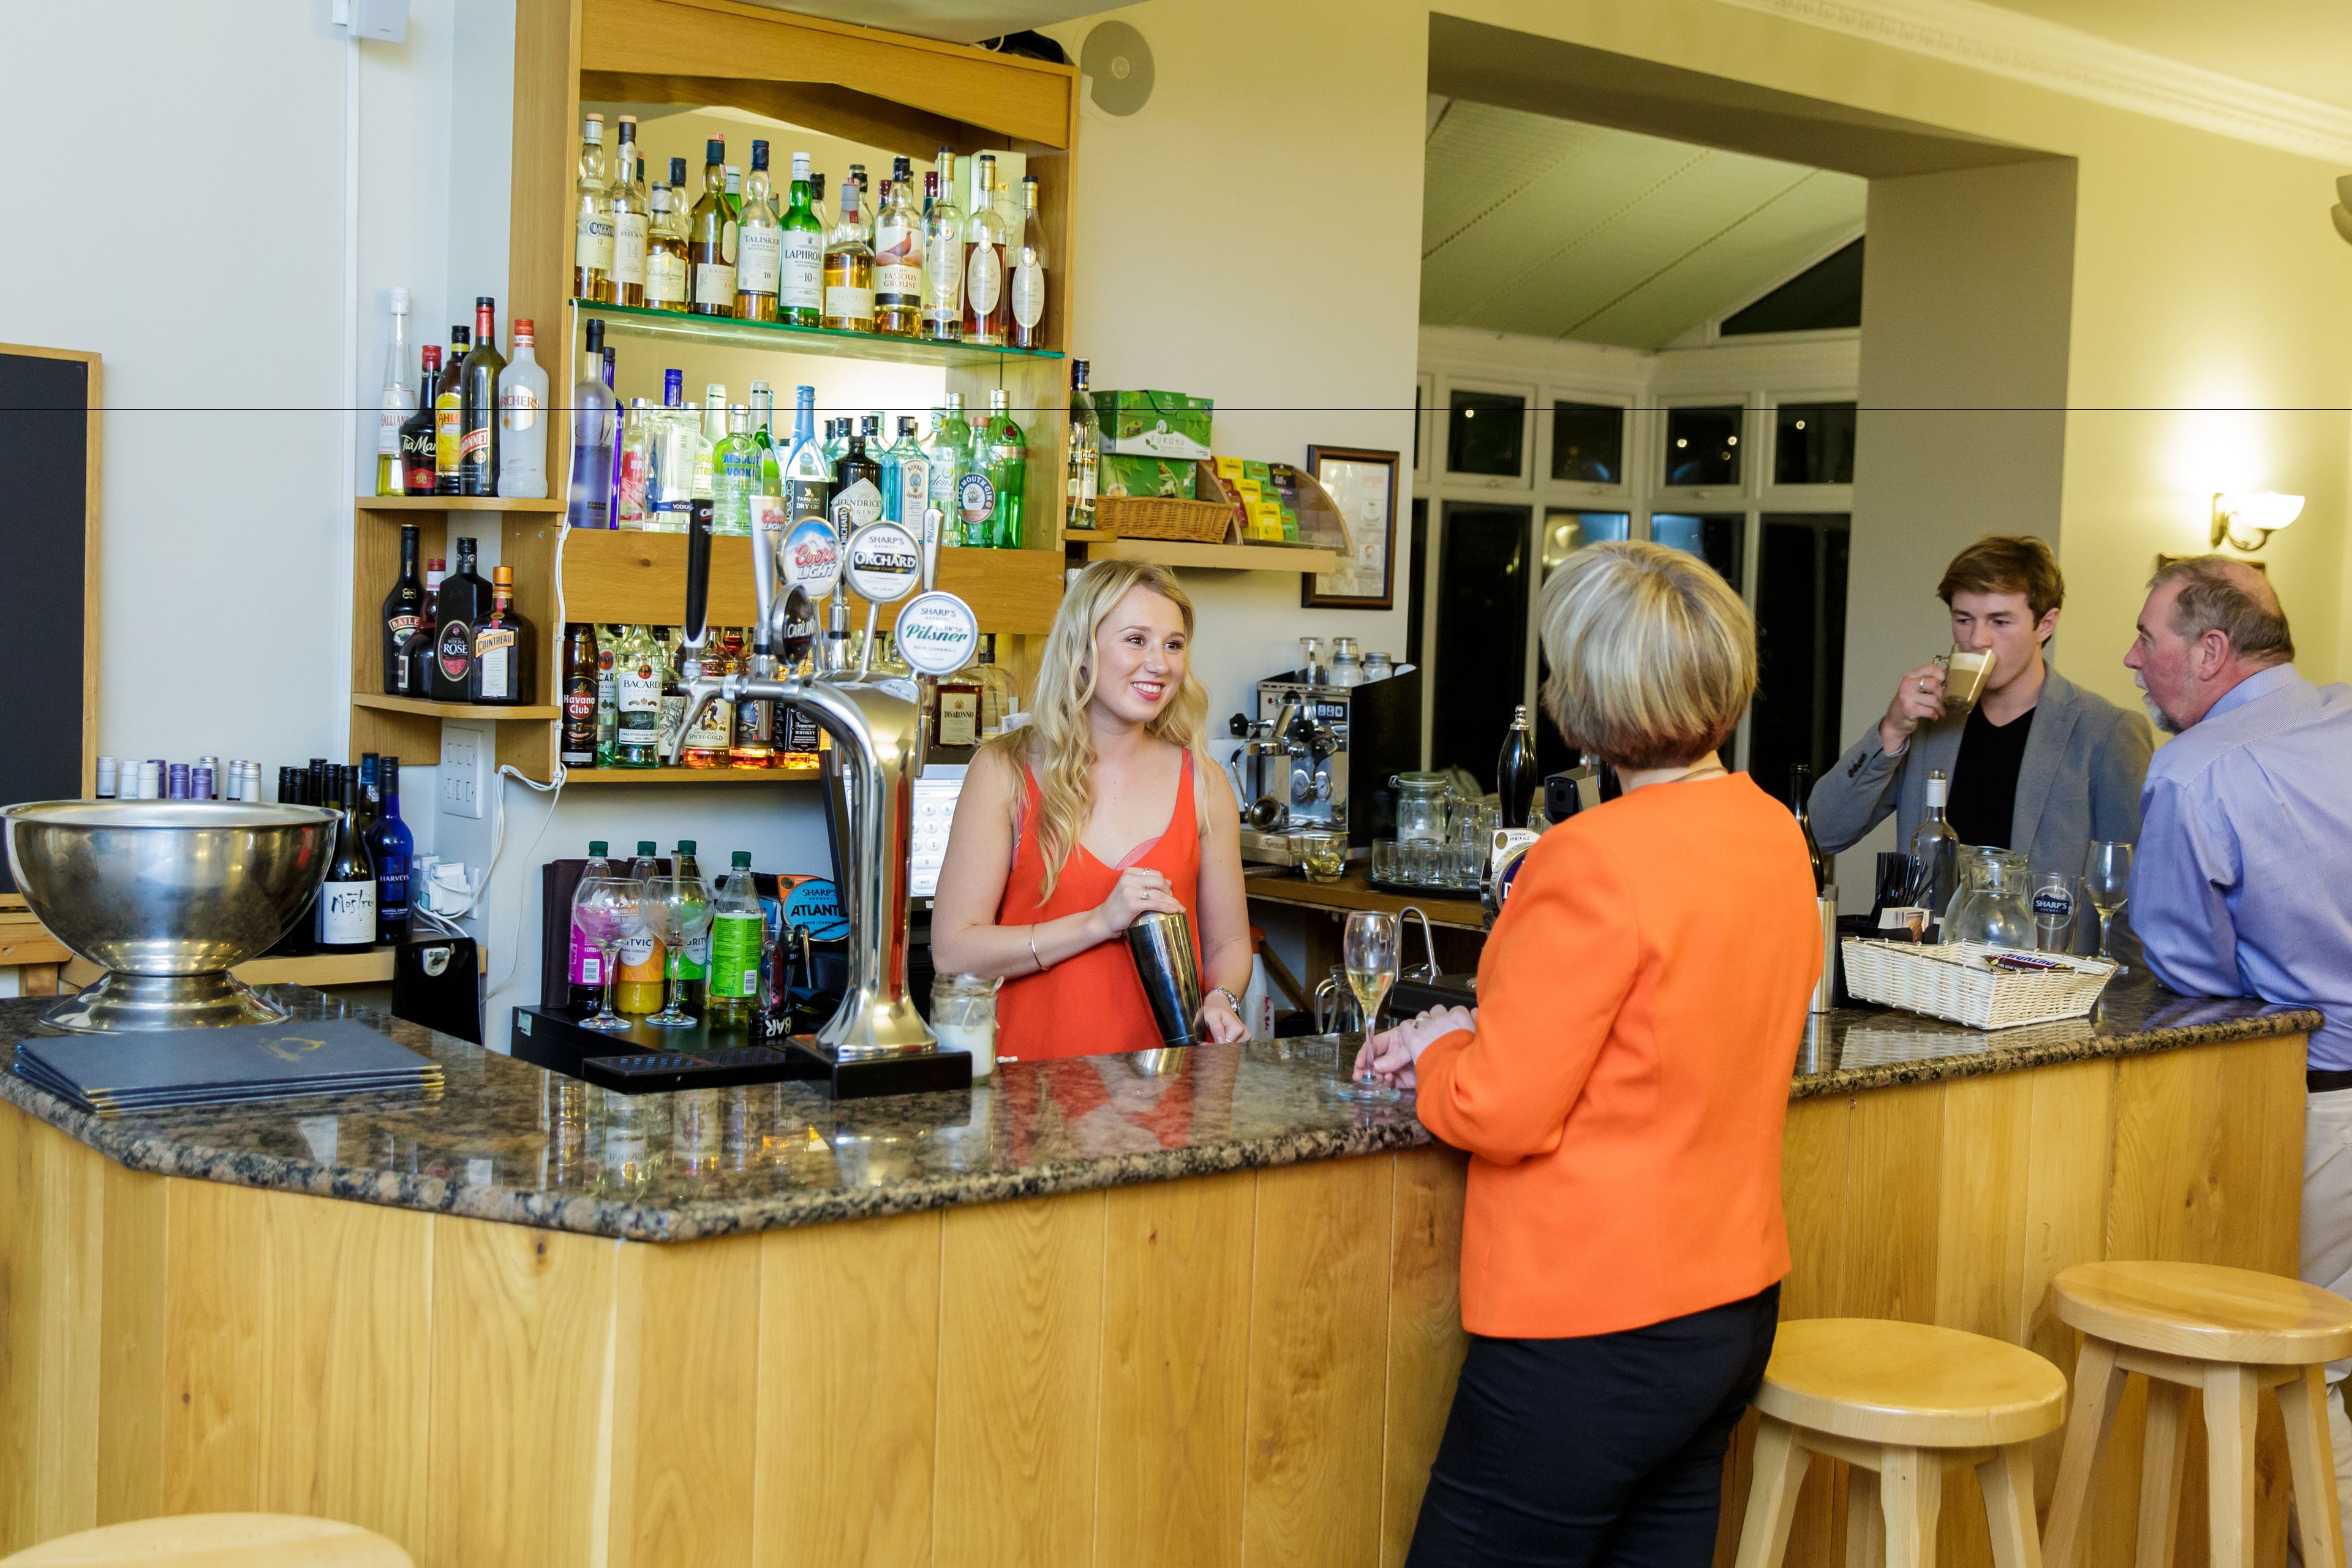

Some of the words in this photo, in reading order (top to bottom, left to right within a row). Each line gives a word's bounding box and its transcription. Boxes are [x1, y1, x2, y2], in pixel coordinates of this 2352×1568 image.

[621, 231, 644, 239] OBAN
[804, 273, 813, 282] 10
[884, 273, 918, 282] FAMOUS
[883, 280, 916, 289] GROUSE
[500, 396, 540, 409] RCHERS
[401, 435, 415, 452] Tia
[723, 454, 760, 466] ABSOLUT
[726, 467, 756, 477] VODKA
[930, 475, 954, 486] don's
[984, 484, 993, 501] GIN
[927, 514, 937, 544] Pilsner
[869, 535, 905, 545] SHARP'S
[795, 544, 838, 568] Coors
[855, 552, 916, 568] ORCHARD
[797, 564, 837, 580] LIGHT
[921, 608, 957, 617] SHARP'S
[391, 617, 420, 628] BAILE
[906, 623, 968, 643] Pilsner
[443, 644, 468, 655] ROSE
[478, 635, 512, 653] COINTREAU
[564, 695, 595, 704] Havana
[570, 704, 589, 714] Club
[577, 723, 584, 731] 7
[790, 904, 839, 917] ATLANT
[2035, 900, 2068, 910] SHARP'S
[765, 1016, 791, 1037] BAR
